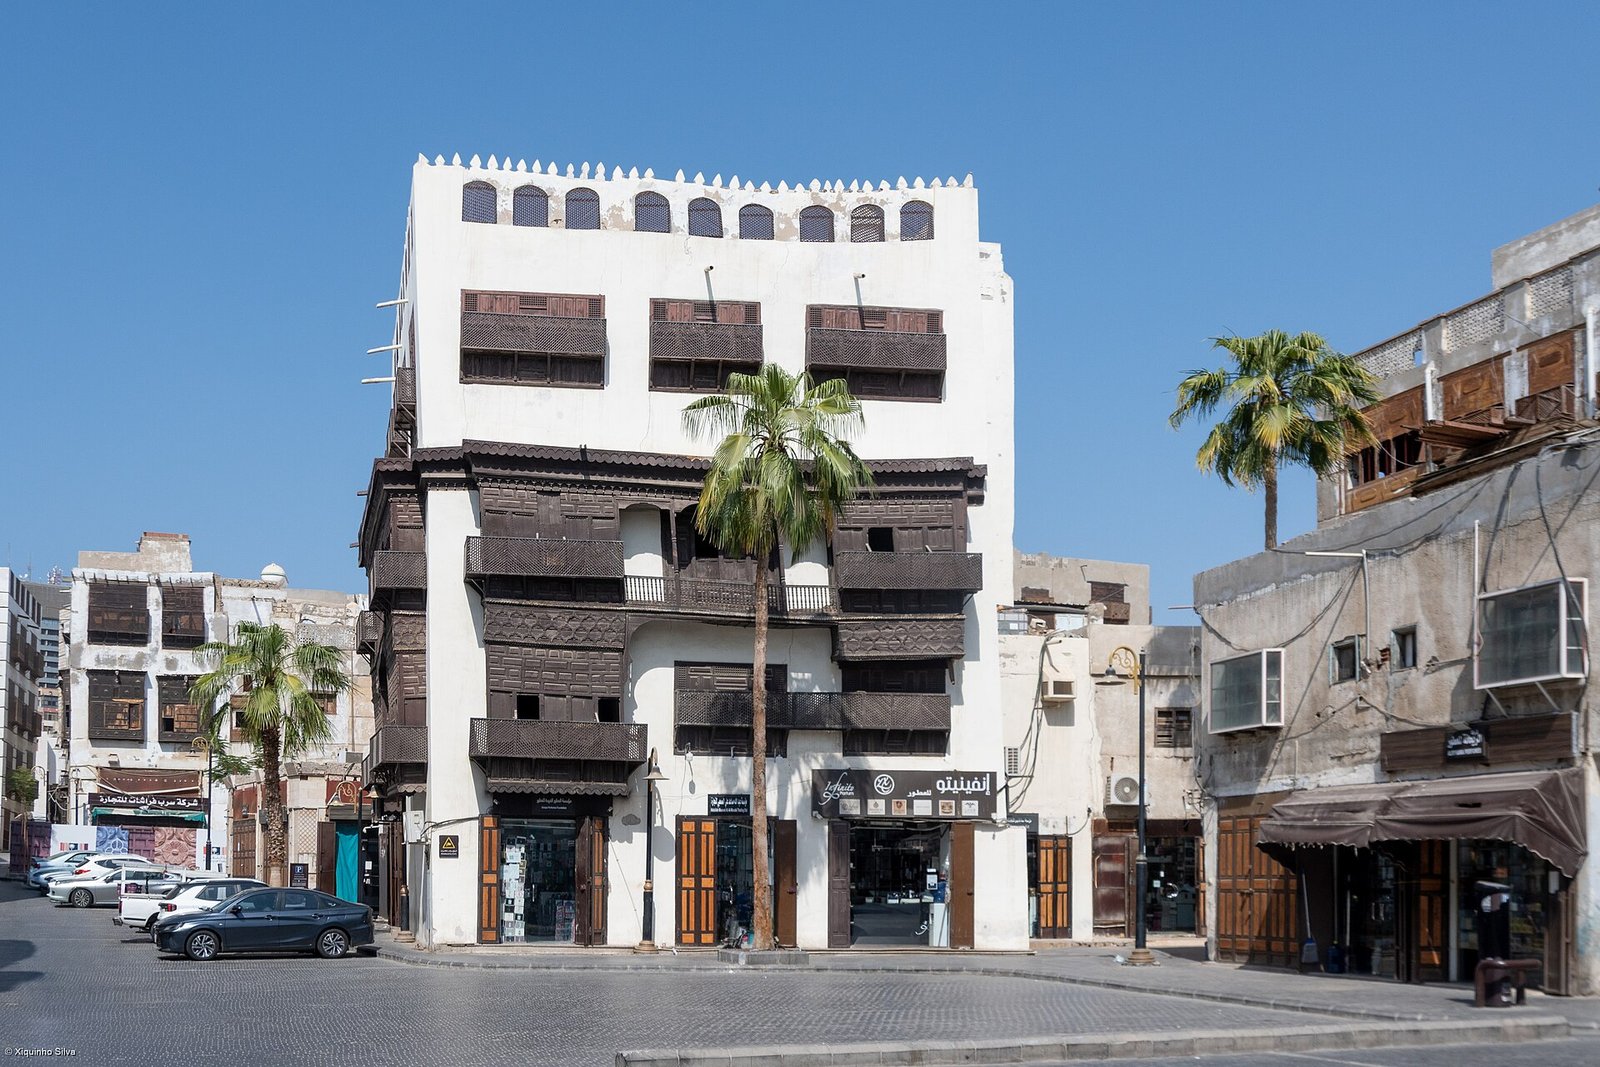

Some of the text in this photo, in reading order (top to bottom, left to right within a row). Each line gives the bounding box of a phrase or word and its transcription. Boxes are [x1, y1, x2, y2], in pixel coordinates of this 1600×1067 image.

[907, 773, 991, 797] إنفينيتو للعطور
[99, 795, 198, 807] شركة سرب فراشات للتجارة
